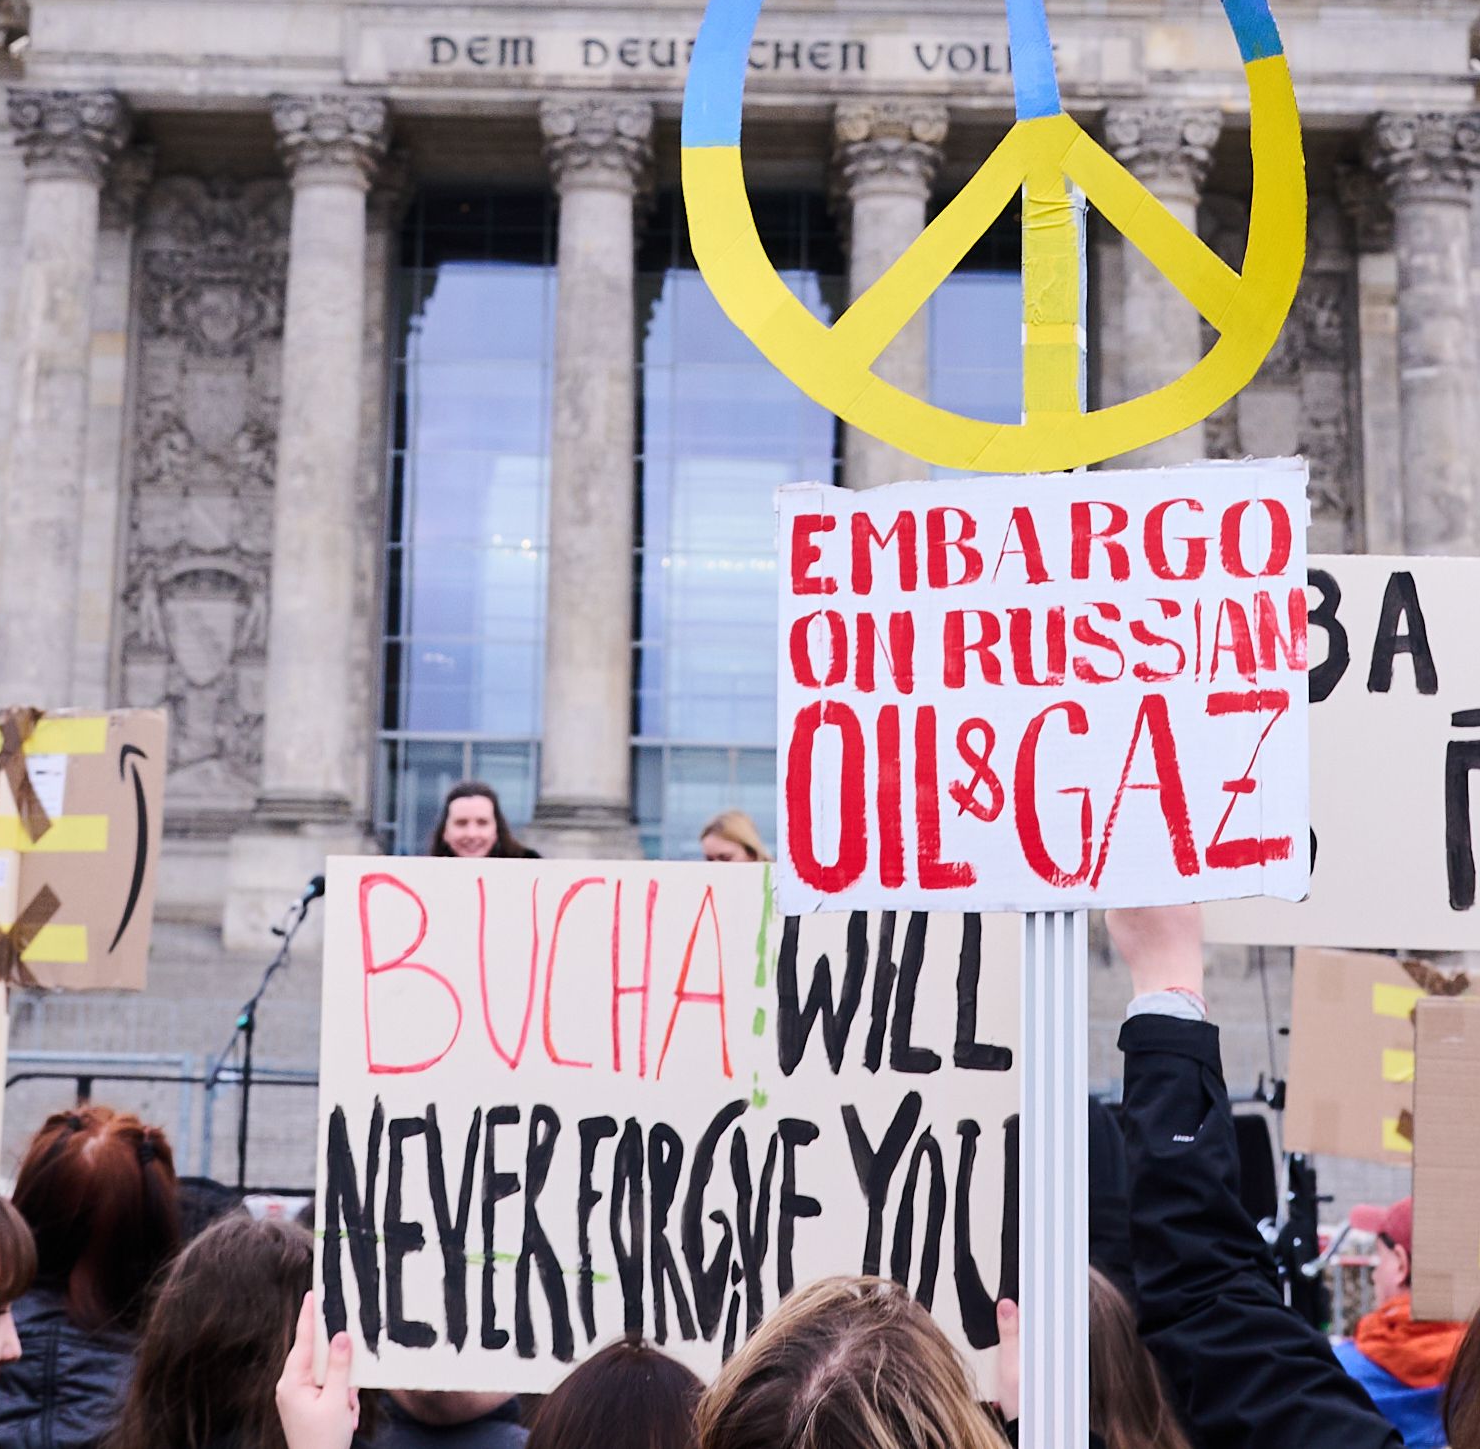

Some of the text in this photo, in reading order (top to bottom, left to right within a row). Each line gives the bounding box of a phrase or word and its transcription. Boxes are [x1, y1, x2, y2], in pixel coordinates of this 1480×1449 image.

[428, 35, 1067, 74] DEM DEUCHEN VOL
[791, 498, 1293, 596] EMBARGO
[788, 587, 1309, 695] ON RUSSIAN
[776, 913, 1013, 1077] WILL
[321, 1094, 578, 1364] NEVER
[839, 1090, 1020, 1350] YOU
